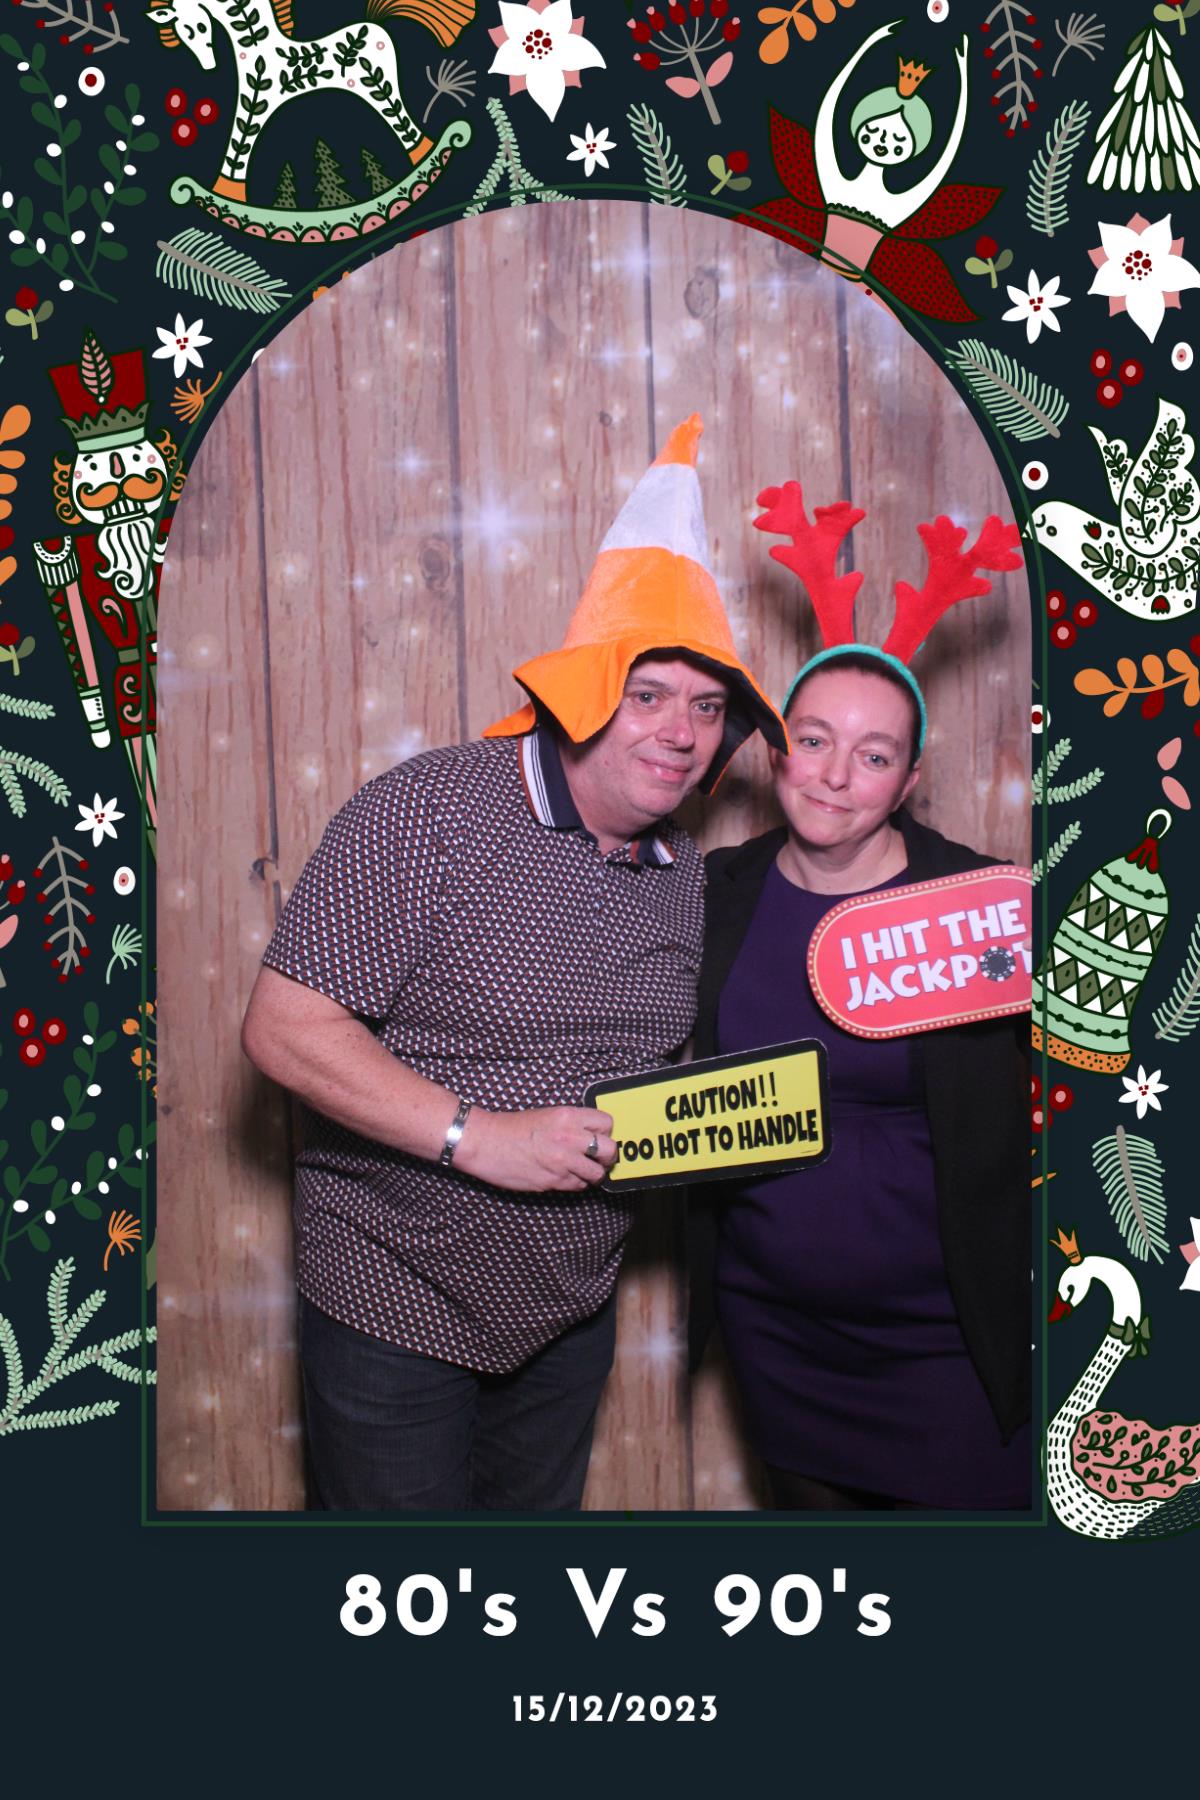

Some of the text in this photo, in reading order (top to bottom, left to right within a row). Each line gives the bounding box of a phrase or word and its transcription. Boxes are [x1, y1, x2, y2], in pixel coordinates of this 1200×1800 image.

[841, 899, 1026, 970] I HIT THE
[665, 1072, 778, 1122] CAUTION!!
[659, 1128, 701, 1159] HOT
[705, 1125, 734, 1151] TO
[736, 1109, 819, 1149] HANDLE
